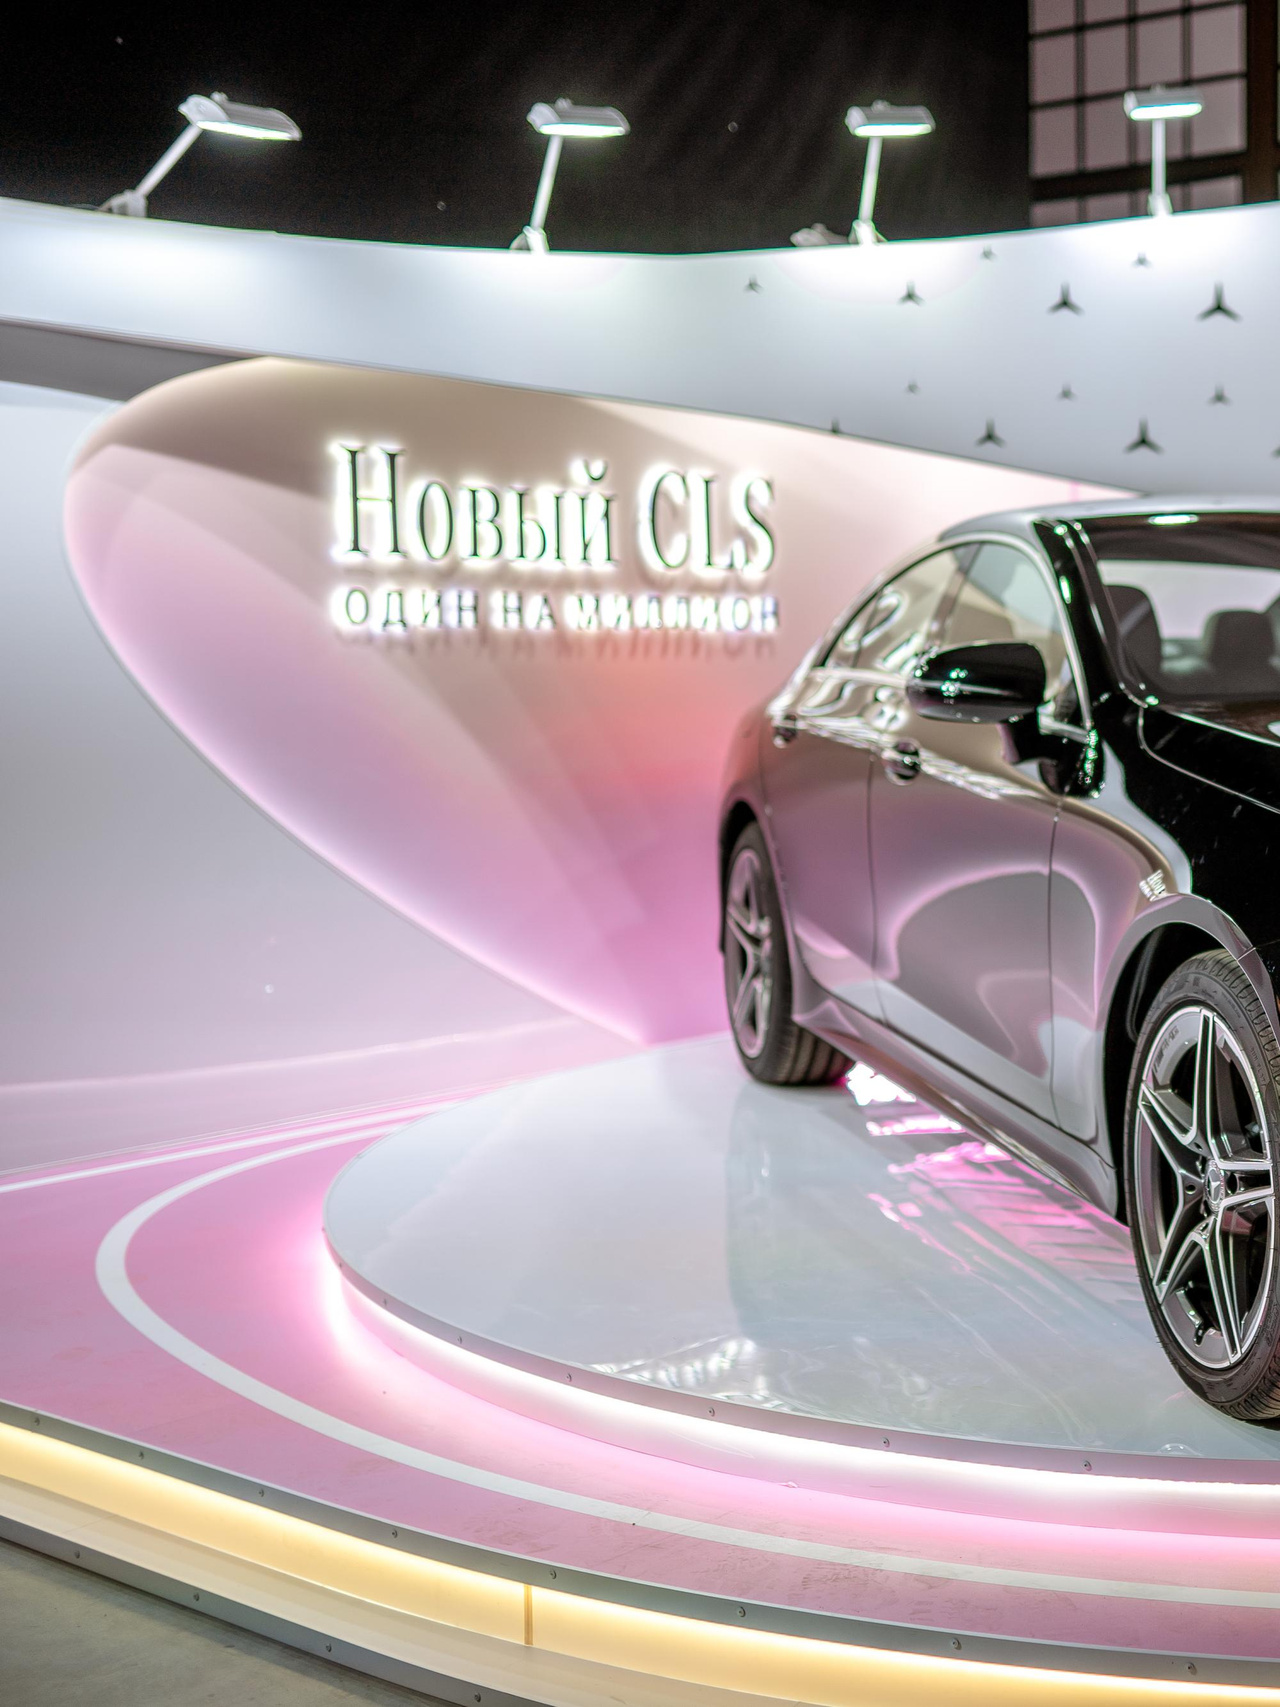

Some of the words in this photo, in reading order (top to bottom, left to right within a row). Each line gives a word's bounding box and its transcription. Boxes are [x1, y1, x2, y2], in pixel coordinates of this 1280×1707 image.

[332, 441, 618, 565] Новый
[642, 468, 776, 575] CLS
[339, 587, 480, 633] ОДИН
[496, 588, 557, 631] НА
